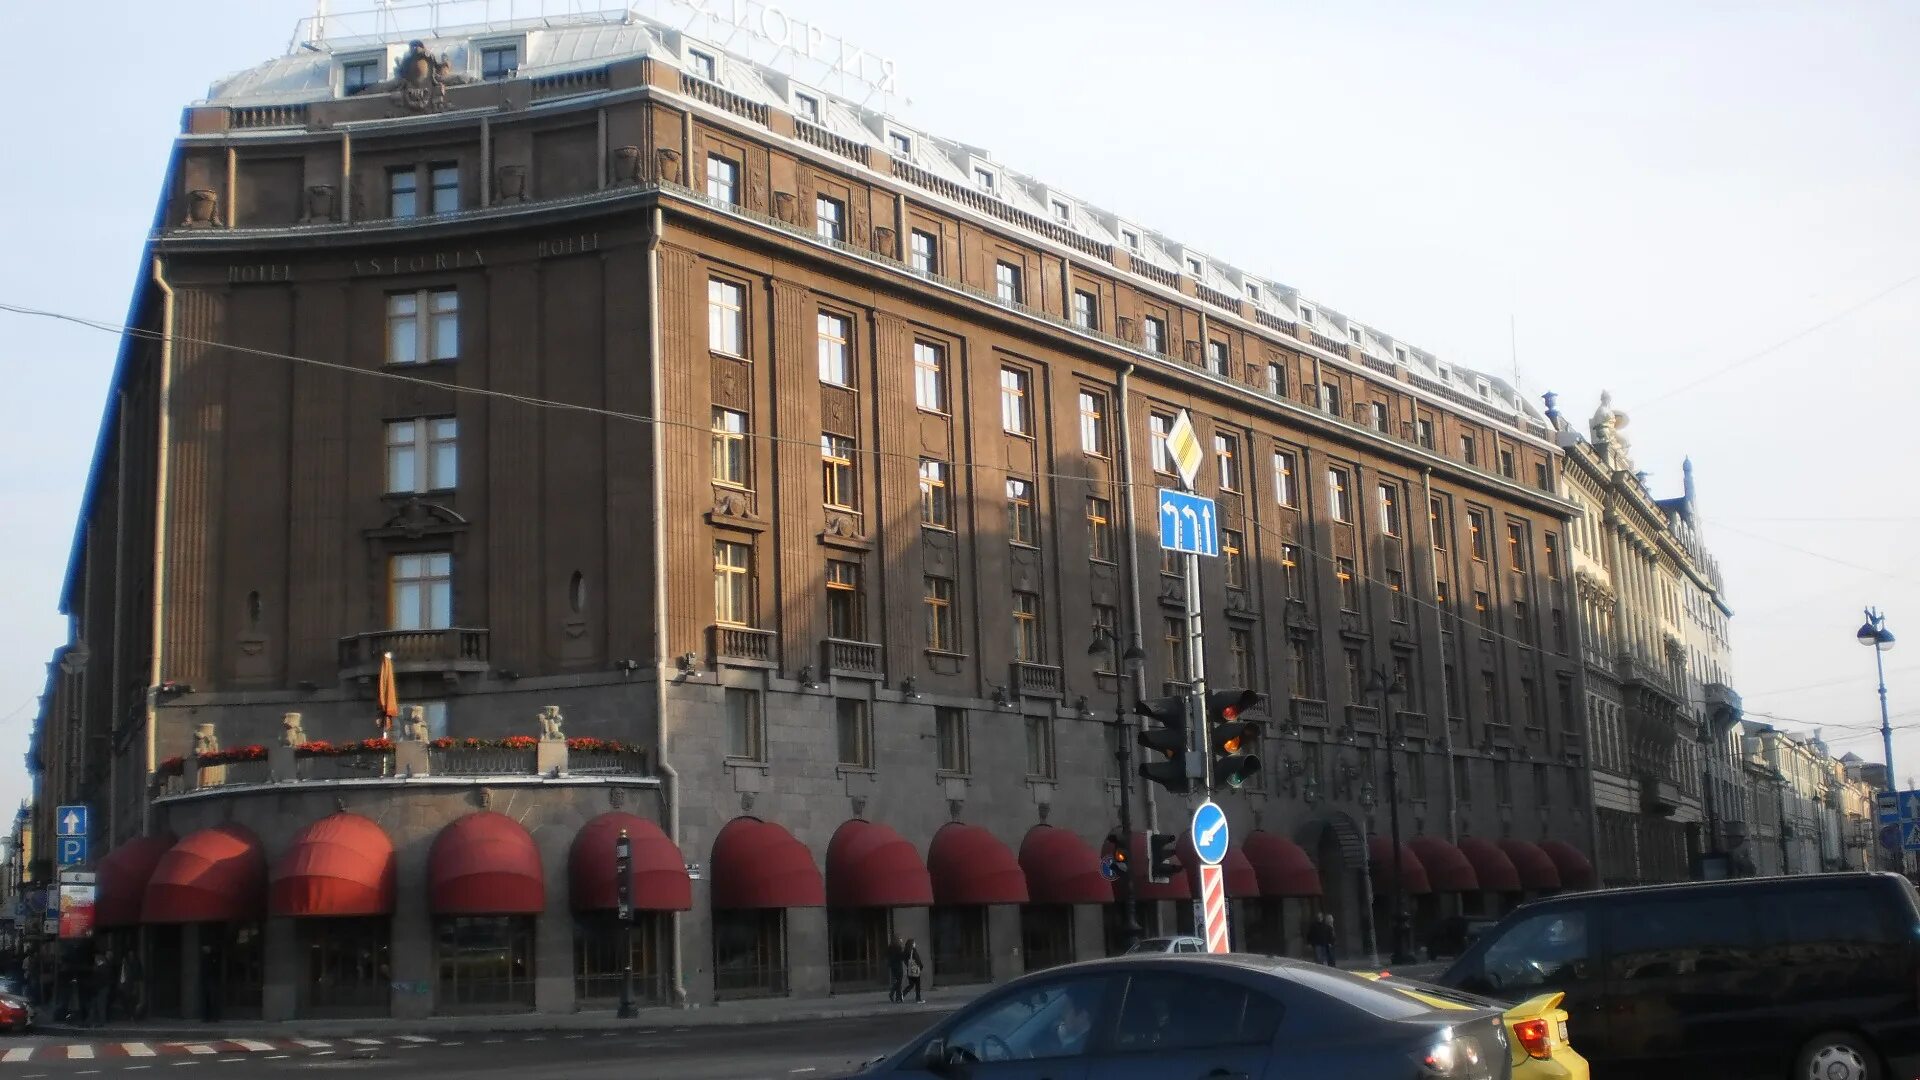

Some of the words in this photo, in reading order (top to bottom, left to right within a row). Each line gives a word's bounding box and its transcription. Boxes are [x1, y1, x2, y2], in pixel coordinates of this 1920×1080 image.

[227, 264, 291, 282] HOTEL
[351, 248, 486, 273] ASTORIA
[537, 232, 601, 257] HOTEL
[64, 840, 80, 862] P
